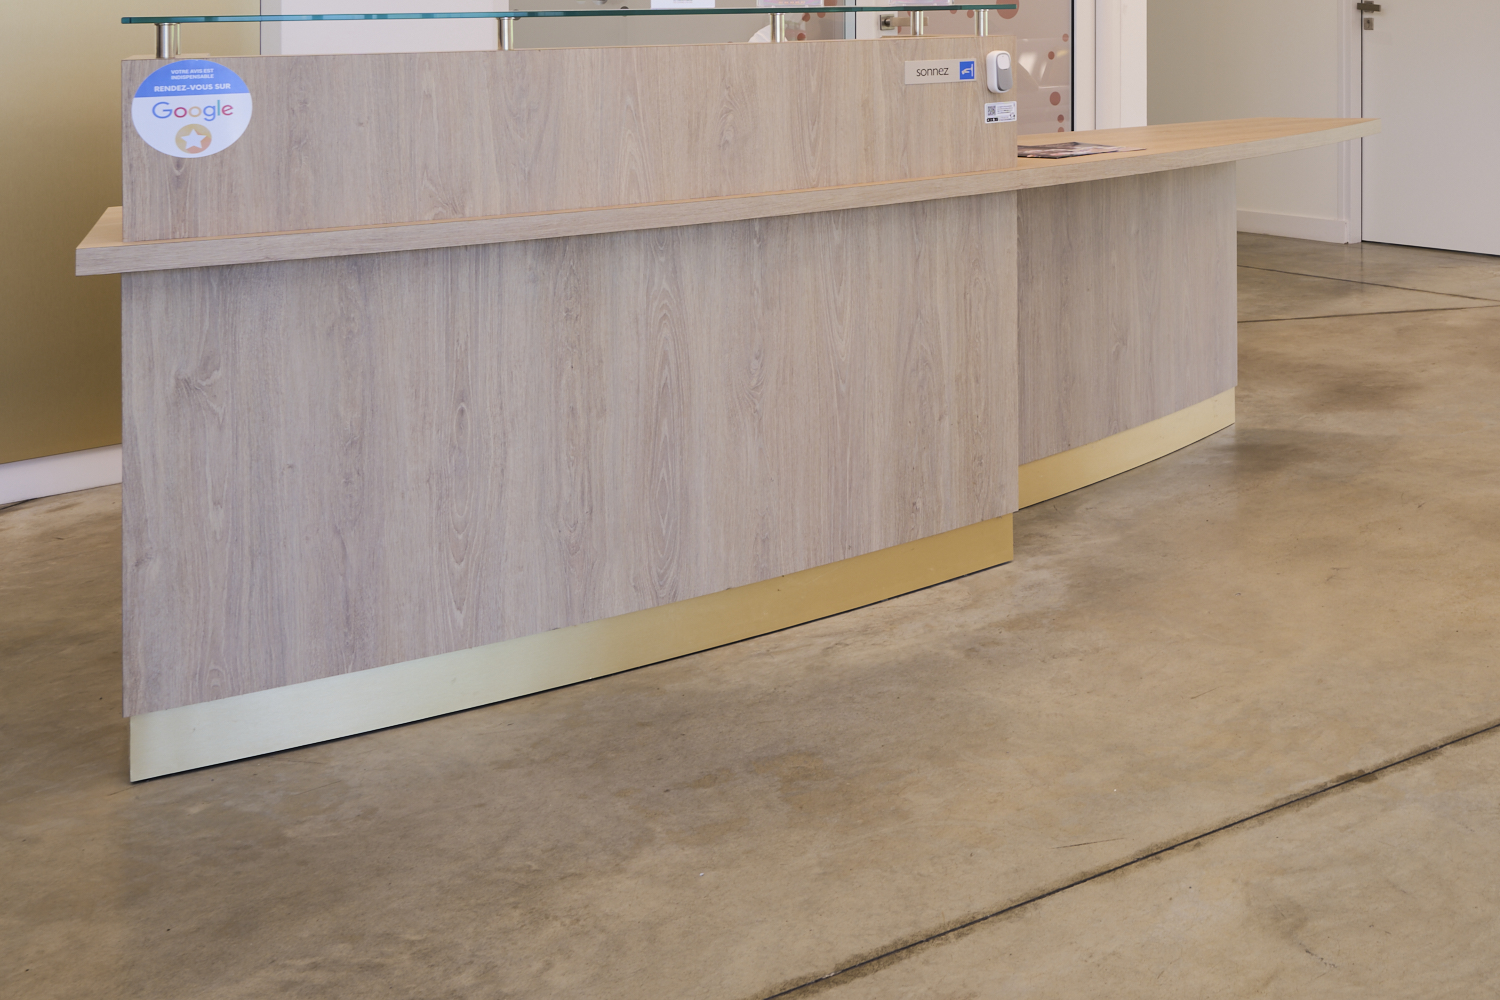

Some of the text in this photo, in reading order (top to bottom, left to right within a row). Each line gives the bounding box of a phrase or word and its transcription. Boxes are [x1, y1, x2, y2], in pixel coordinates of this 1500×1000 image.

[916, 67, 949, 76] sonnez
[154, 83, 213, 92] RENDEZ-VOUS
[152, 99, 234, 121] Google
